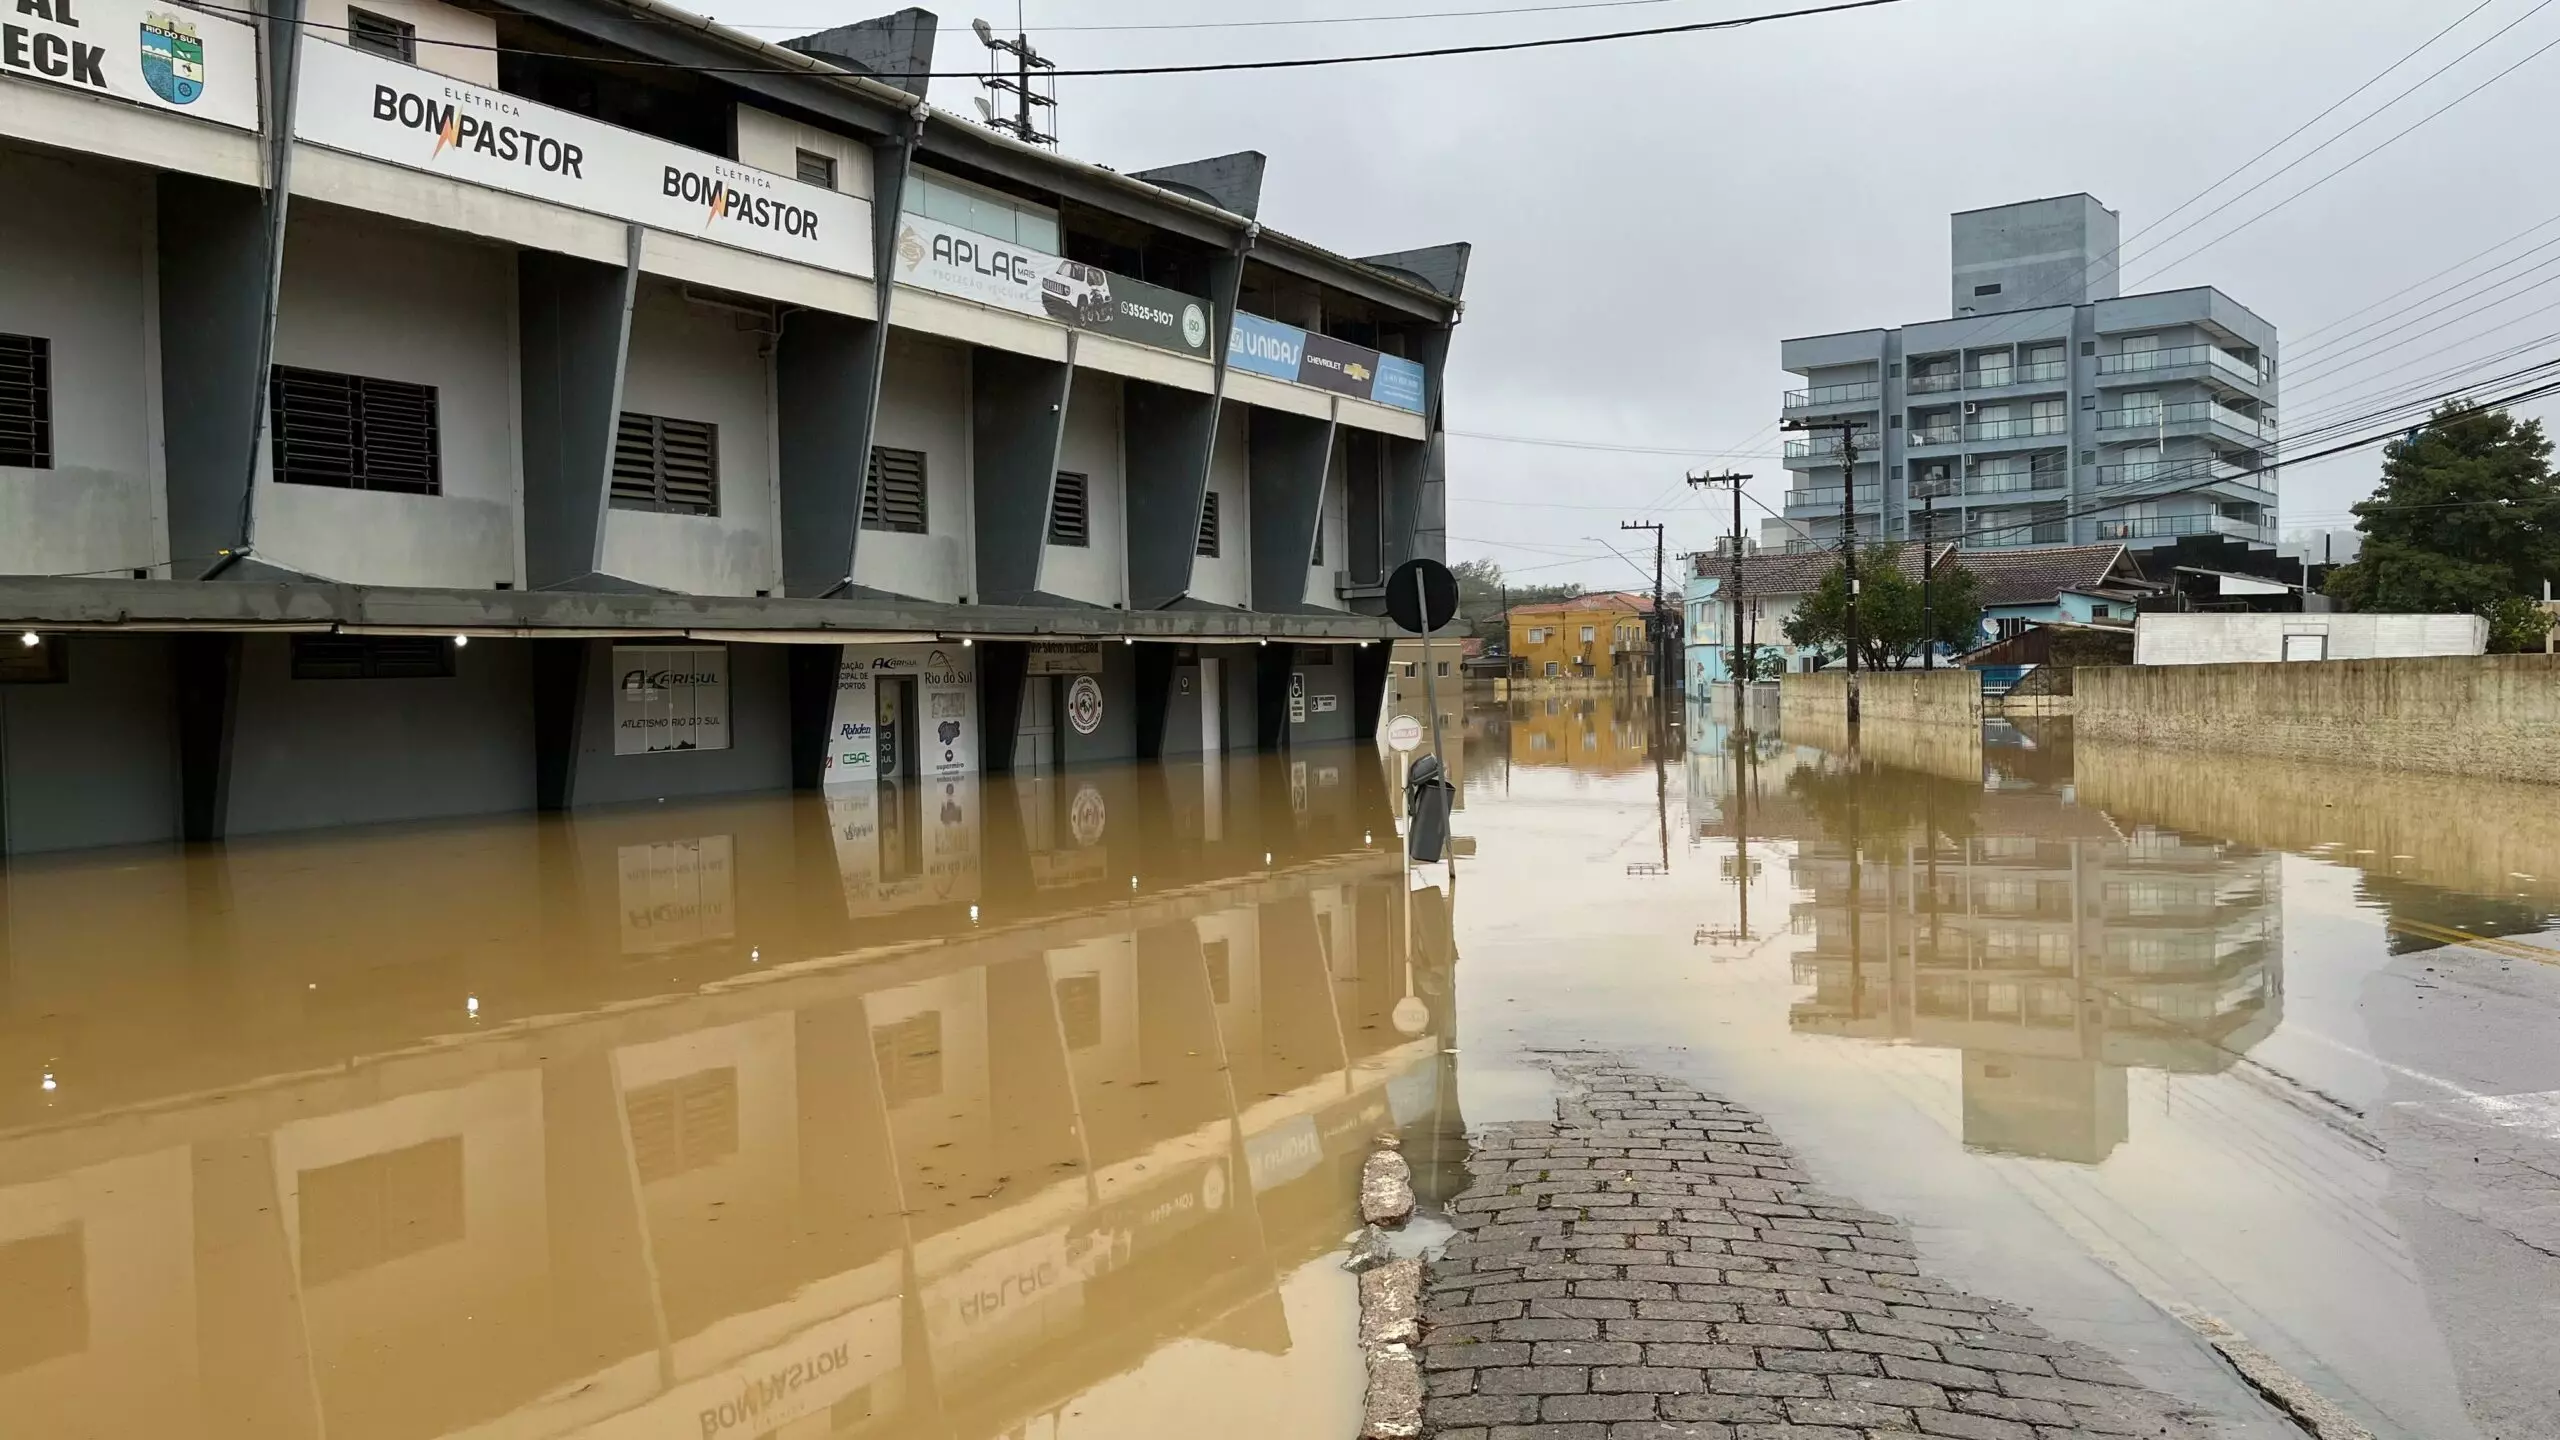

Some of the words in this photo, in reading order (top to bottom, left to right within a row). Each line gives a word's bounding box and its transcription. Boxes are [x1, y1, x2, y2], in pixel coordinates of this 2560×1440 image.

[145, 25, 162, 35] RIO
[164, 30, 178, 39] DO
[180, 35, 198, 46] SUL
[2, 23, 107, 88] ECK
[444, 87, 520, 117] ELÉTRICA
[932, 233, 1029, 286] APLAC
[1017, 267, 1036, 279] MAIS
[1128, 302, 1173, 326] 3525-5107
[1246, 331, 1299, 366] UNIDAS
[1306, 354, 1341, 371] CHEVROLET
[860, 672, 869, 680] DE
[924, 672, 941, 684] Rio
[943, 672, 956, 684] do
[957, 671, 973, 684] Sul
[621, 719, 669, 728] ATLETISMO
[671, 717, 686, 727] RIO
[688, 717, 702, 726] DO
[704, 716, 720, 725] SUL
[840, 723, 872, 740] Rohden
